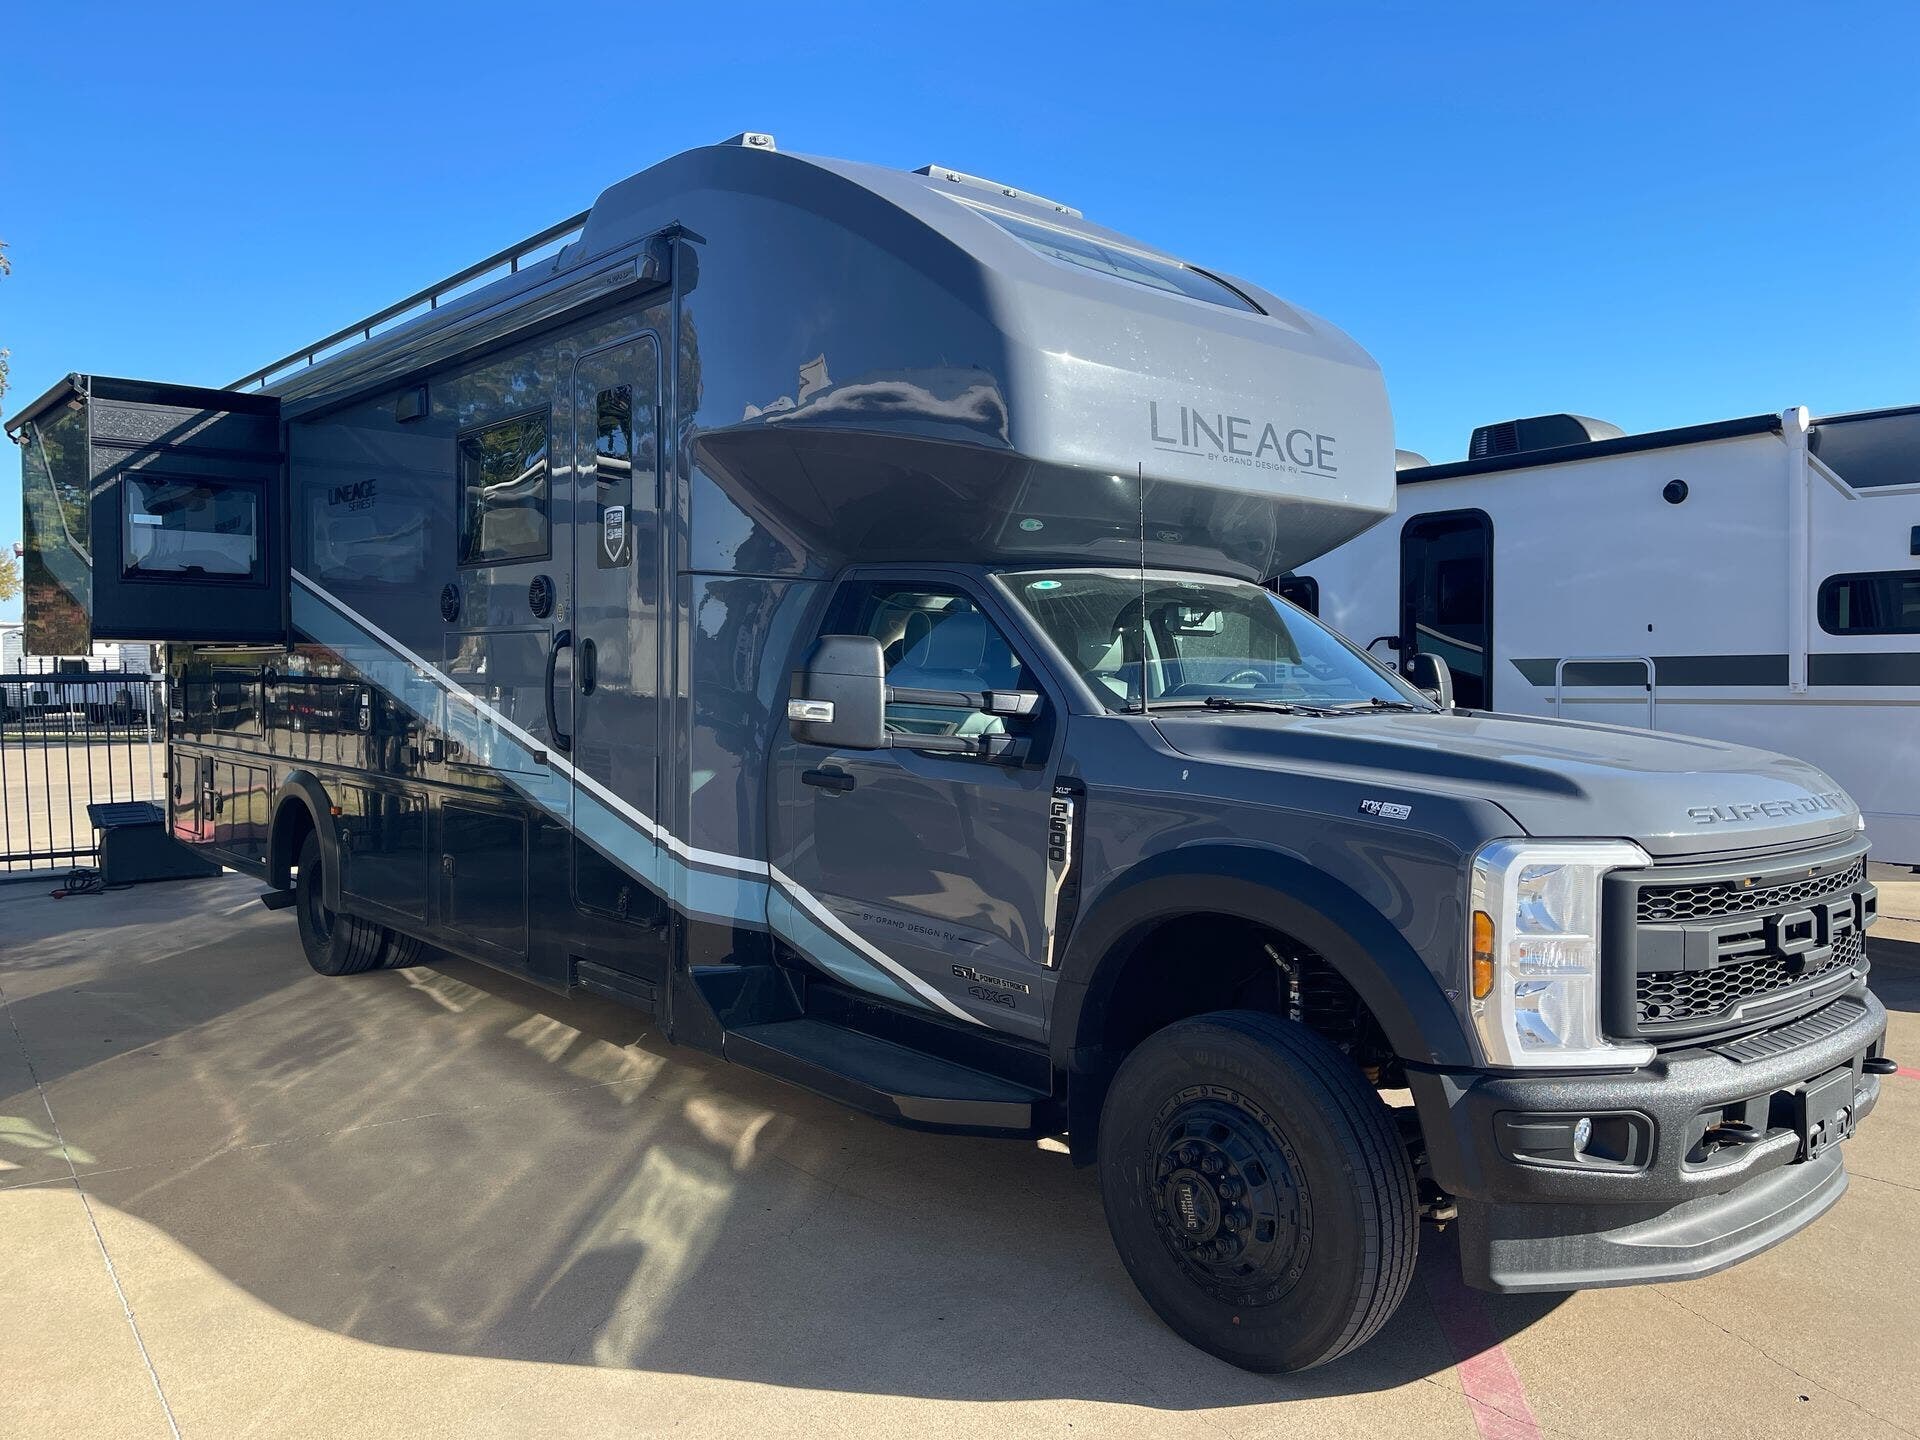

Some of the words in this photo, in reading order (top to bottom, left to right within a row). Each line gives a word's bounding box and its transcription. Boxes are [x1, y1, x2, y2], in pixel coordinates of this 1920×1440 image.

[1150, 401, 1338, 472] LINEAGE
[1208, 453, 1219, 461] BY
[1222, 455, 1252, 466] GRAND
[1255, 461, 1286, 472] DESIGN
[1288, 466, 1298, 474] RV
[328, 479, 377, 506] LINEAGE
[1055, 786, 1072, 794] XLT
[1361, 799, 1382, 815] FOX
[1382, 805, 1408, 816] BDS
[1687, 799, 1801, 825] SUPER
[1797, 791, 1844, 812] DUTY
[862, 913, 874, 921] BY
[876, 916, 905, 929] GRAND
[907, 923, 940, 938] DESIGN
[943, 932, 955, 941] RV
[1708, 882, 1878, 969] FORD
[979, 974, 1001, 985] POWER
[1181, 1187, 1197, 1228] TORQUE
